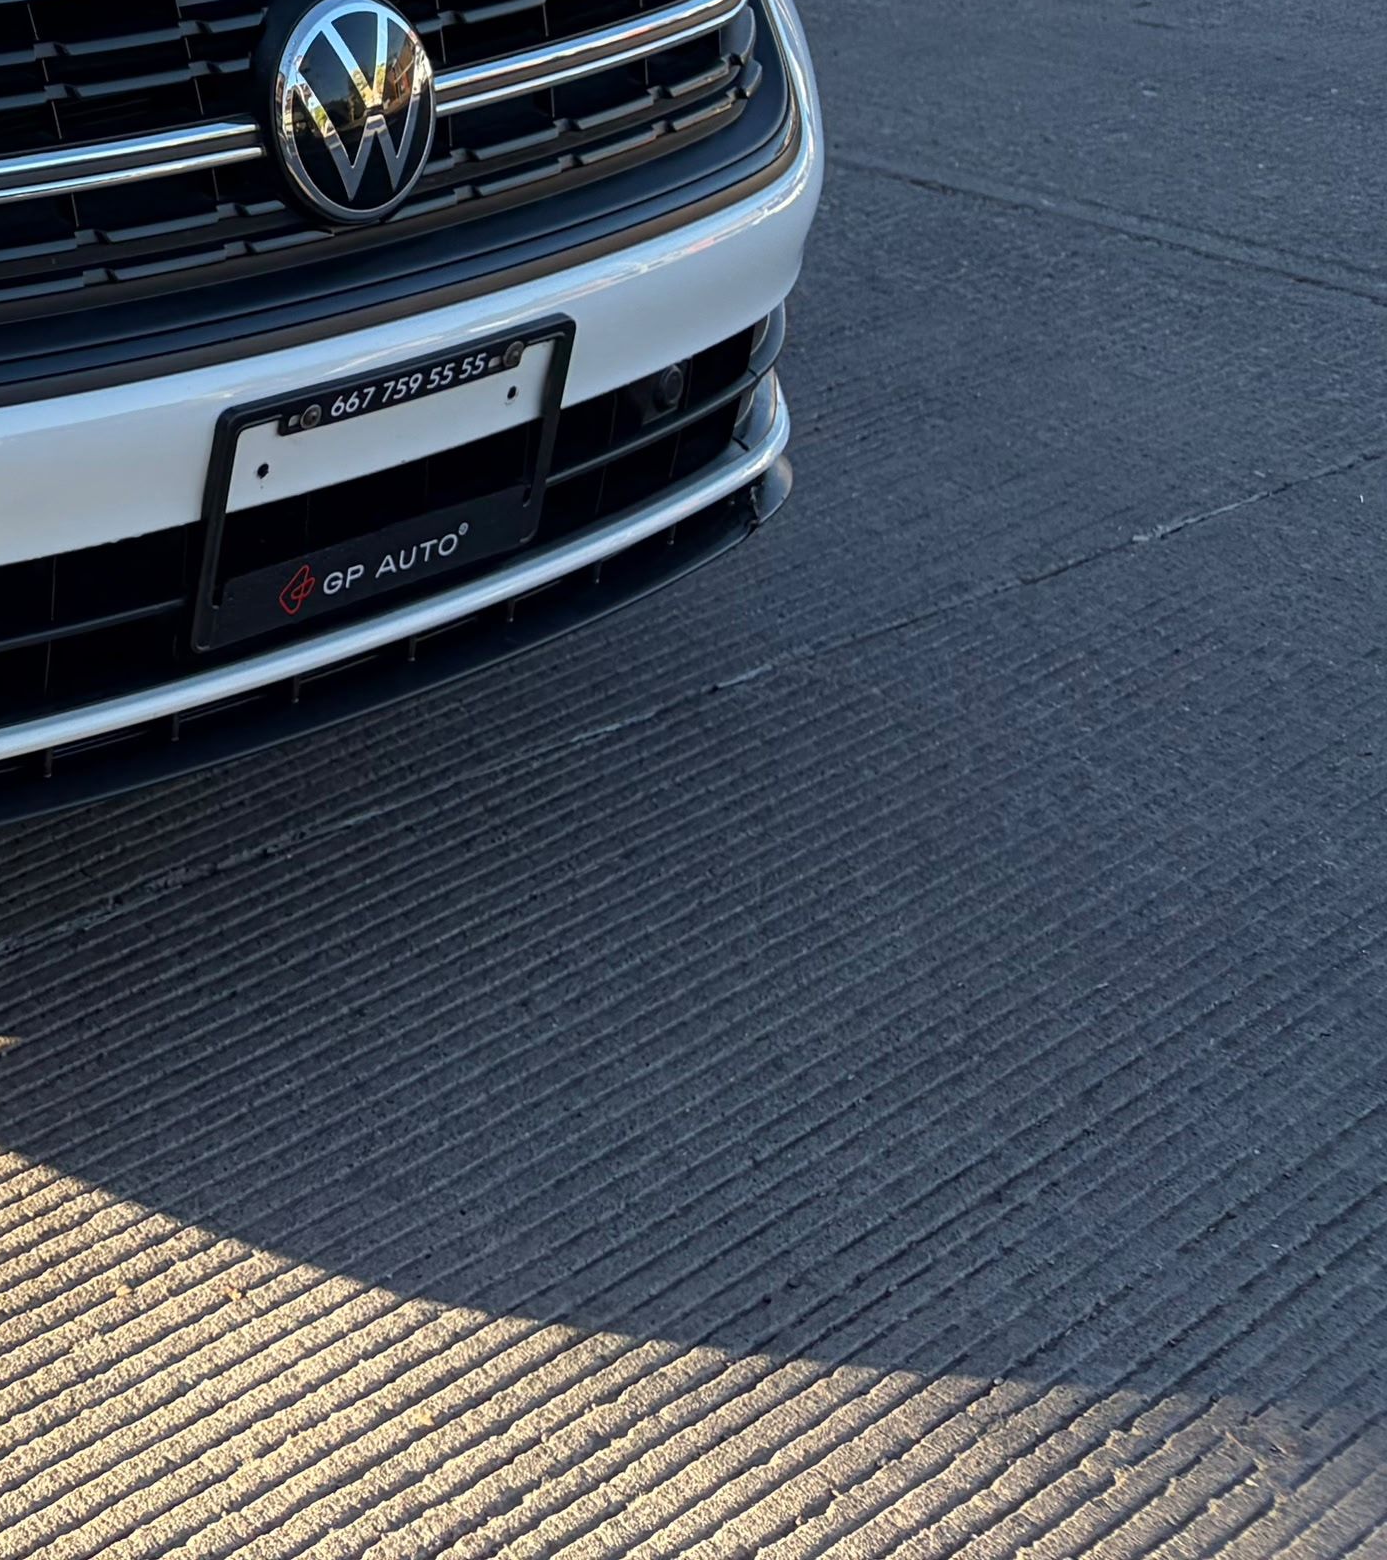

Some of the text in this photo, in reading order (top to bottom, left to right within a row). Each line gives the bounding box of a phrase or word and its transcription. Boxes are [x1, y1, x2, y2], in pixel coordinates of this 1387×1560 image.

[331, 352, 487, 417] 667 759 55 55
[322, 564, 365, 595] GP
